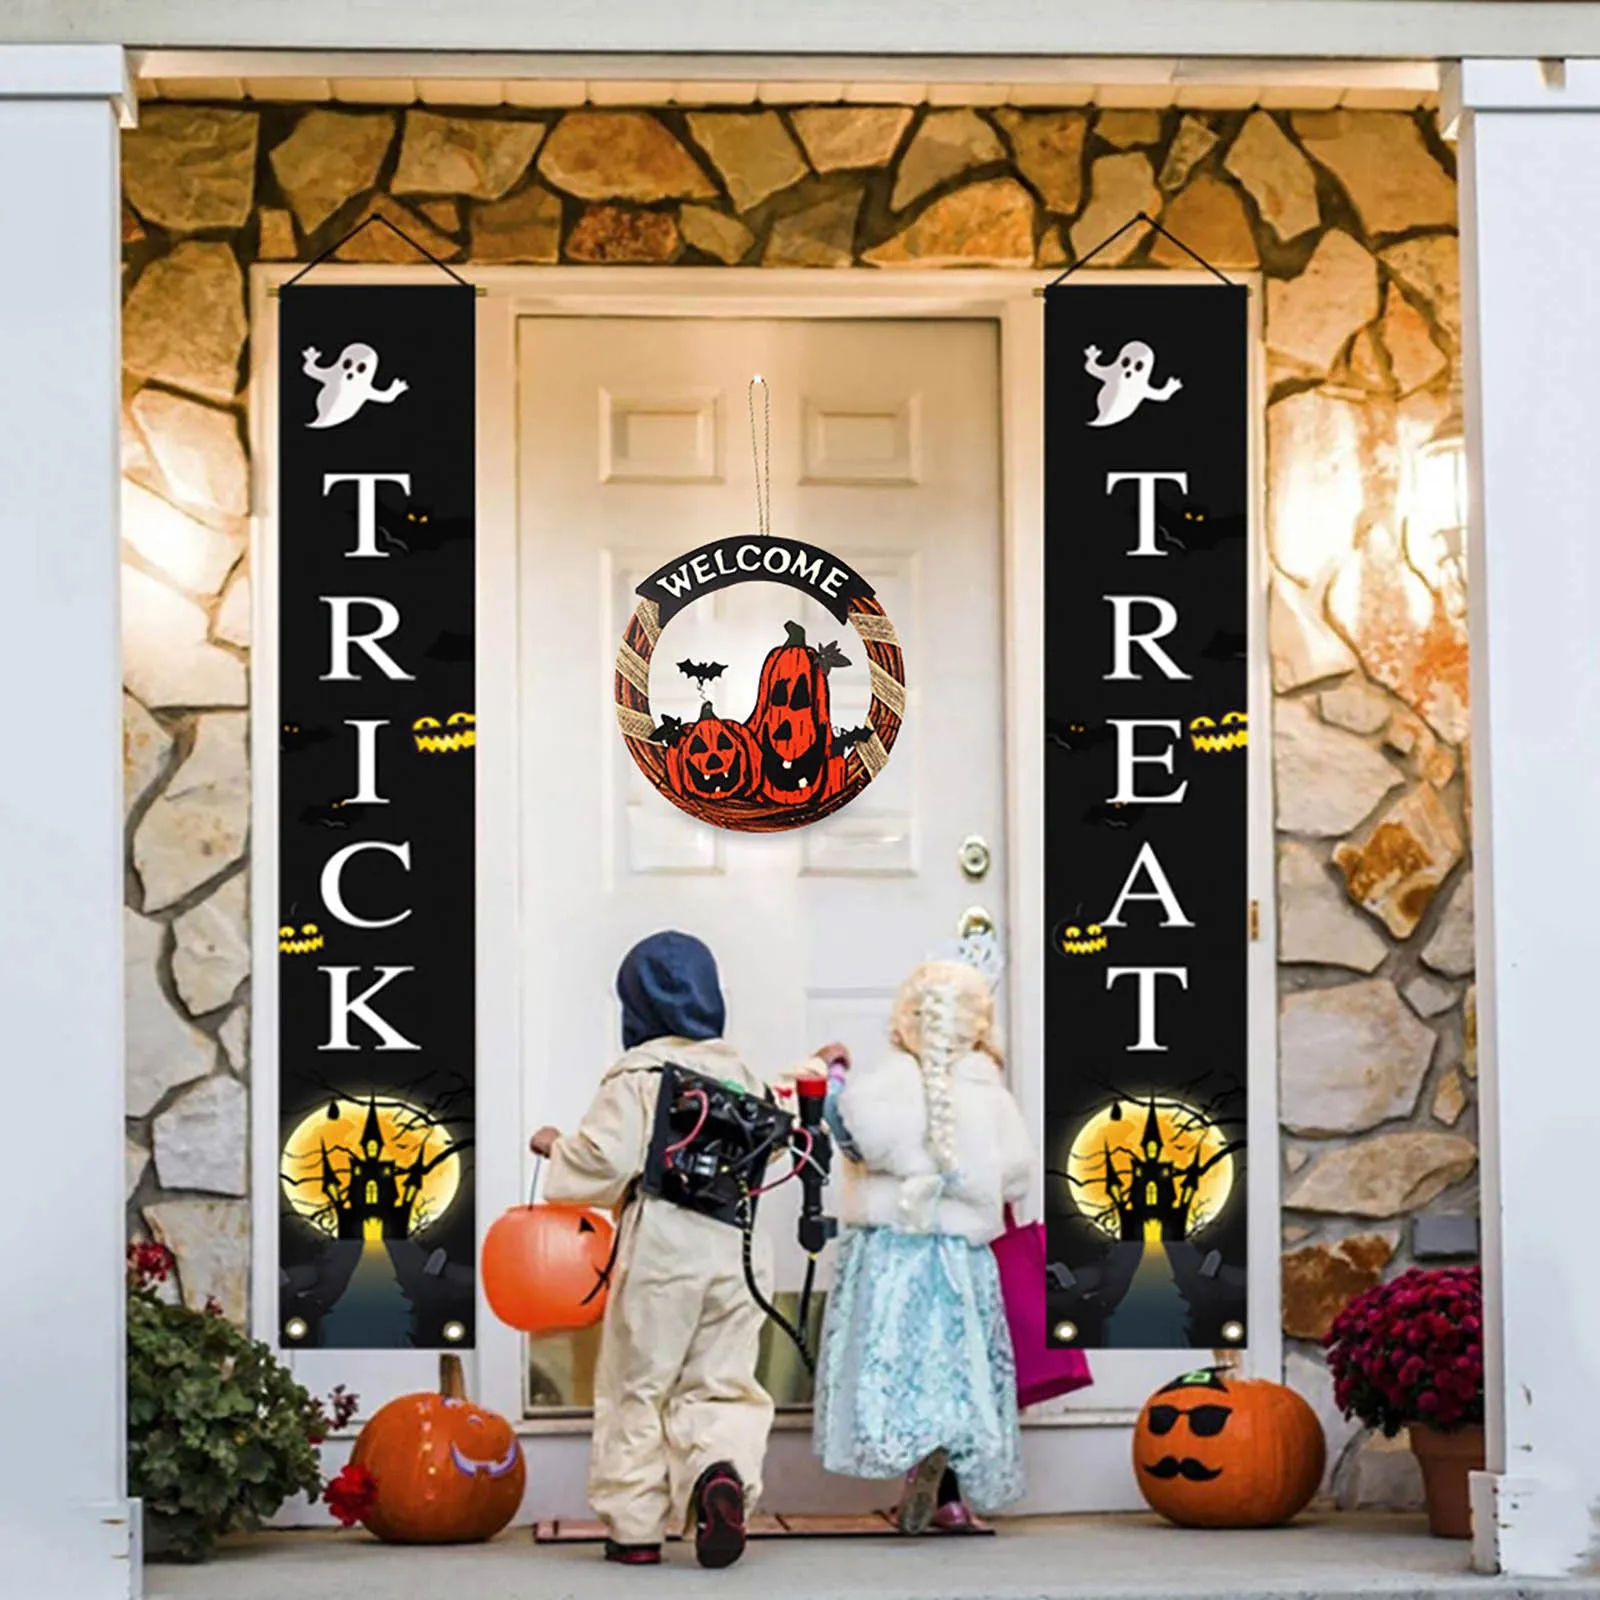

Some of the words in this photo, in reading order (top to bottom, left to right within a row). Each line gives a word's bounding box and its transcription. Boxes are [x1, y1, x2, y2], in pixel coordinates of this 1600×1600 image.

[318, 472, 420, 1051] TRICK
[656, 544, 850, 600] WELCOME
[1103, 472, 1194, 1052] TREAT
